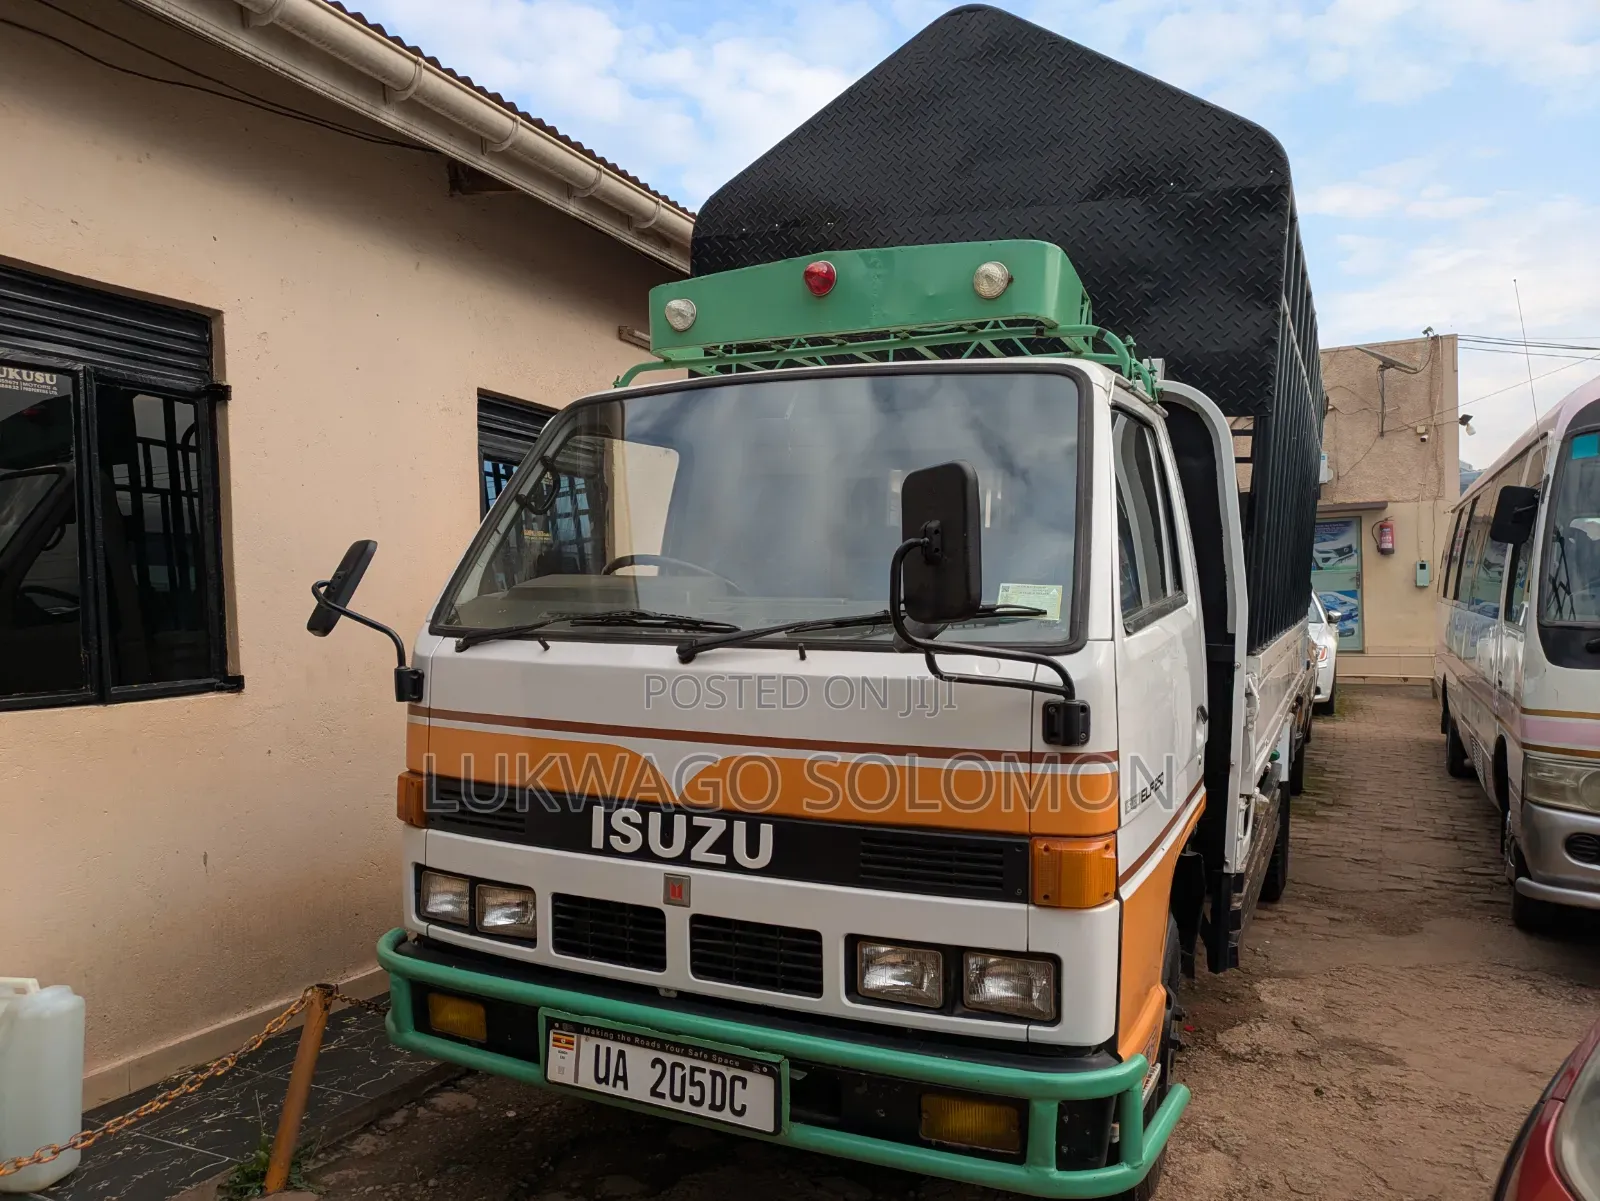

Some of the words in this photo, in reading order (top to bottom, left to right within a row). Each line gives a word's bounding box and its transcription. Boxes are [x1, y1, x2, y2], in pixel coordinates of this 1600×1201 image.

[591, 805, 774, 870] ISUZU
[583, 1026, 614, 1040] Making
[617, 1033, 631, 1043] the
[634, 1036, 661, 1050] Roads
[665, 1043, 685, 1055] Your
[688, 1048, 708, 1060] Safe
[711, 1053, 741, 1067] Space
[594, 1044, 629, 1091] UA
[650, 1057, 748, 1118] 205DC
